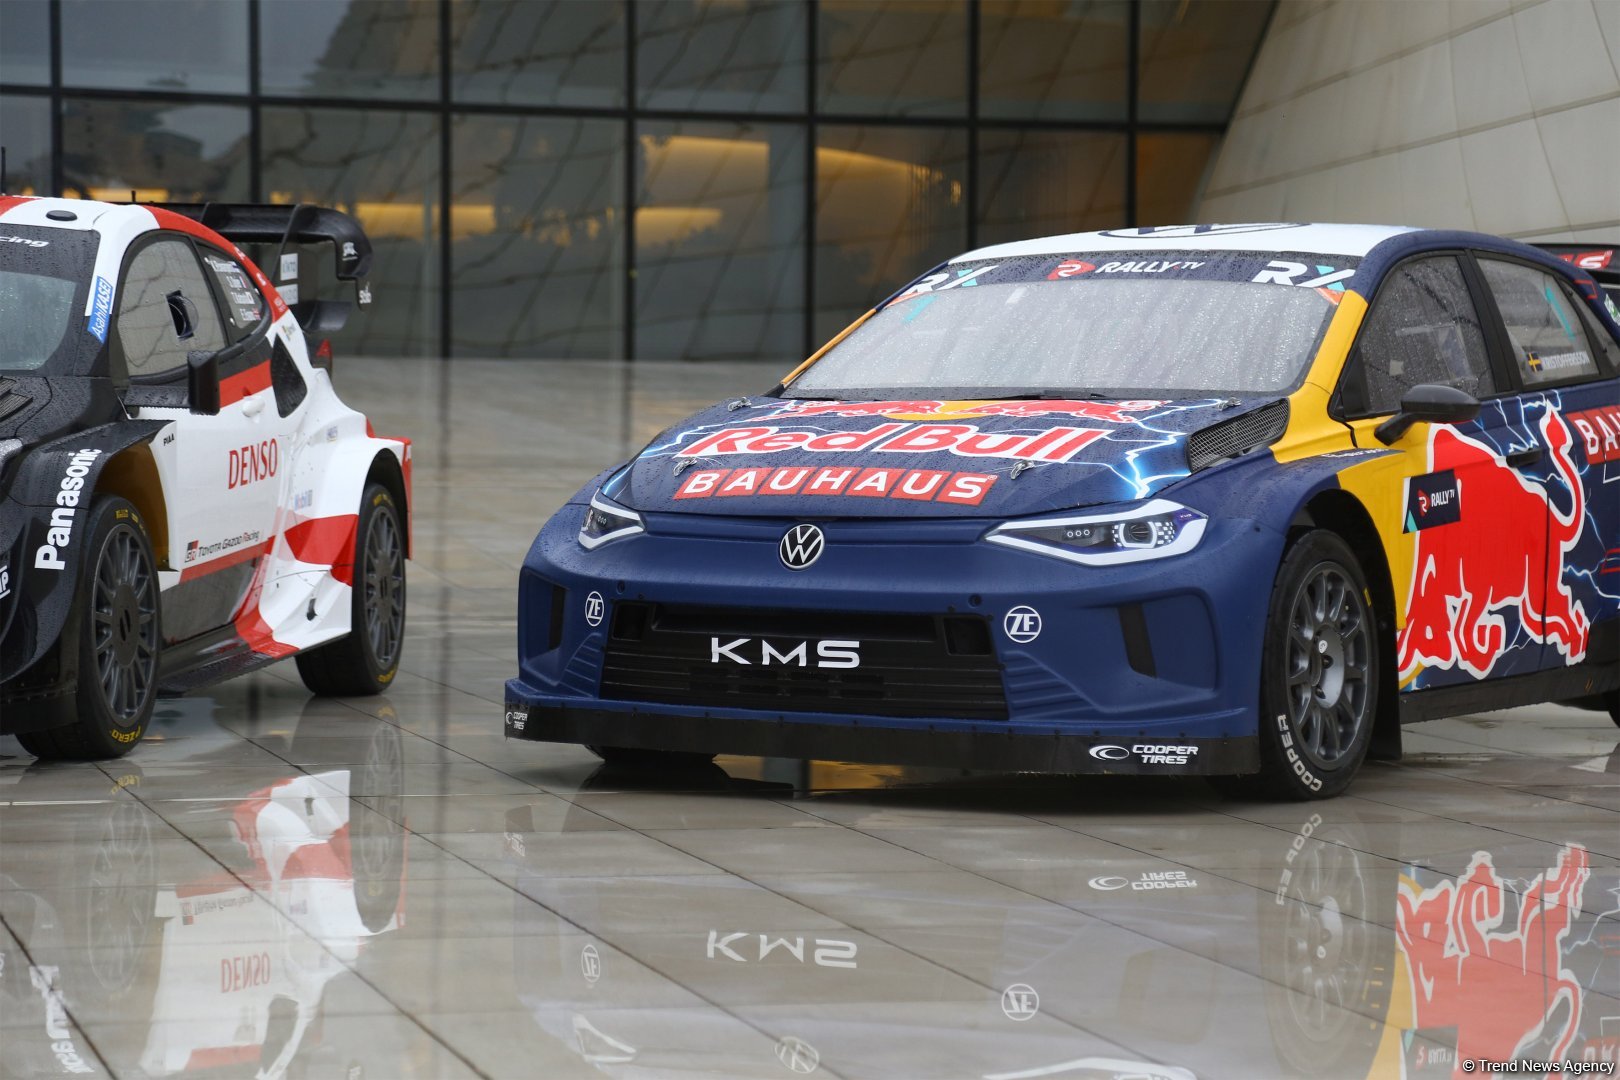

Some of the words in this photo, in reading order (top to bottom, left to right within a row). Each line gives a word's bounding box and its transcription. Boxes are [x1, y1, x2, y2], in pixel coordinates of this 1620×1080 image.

[1095, 261, 1180, 274] RALLY
[1181, 262, 1206, 270] TV
[1252, 260, 1356, 292] RX
[163, 433, 175, 447] PIAA
[675, 423, 914, 458] Red
[882, 424, 1108, 463] Bull
[229, 438, 278, 489] DENSO
[34, 449, 102, 571] Panasonic
[1431, 490, 1450, 507] RALLY
[1005, 611, 1041, 637] ZF
[711, 637, 860, 669] KMS
[1132, 744, 1199, 755] COOPER
[1141, 754, 1188, 765] TIRES
[1278, 714, 1323, 791] COOPER
